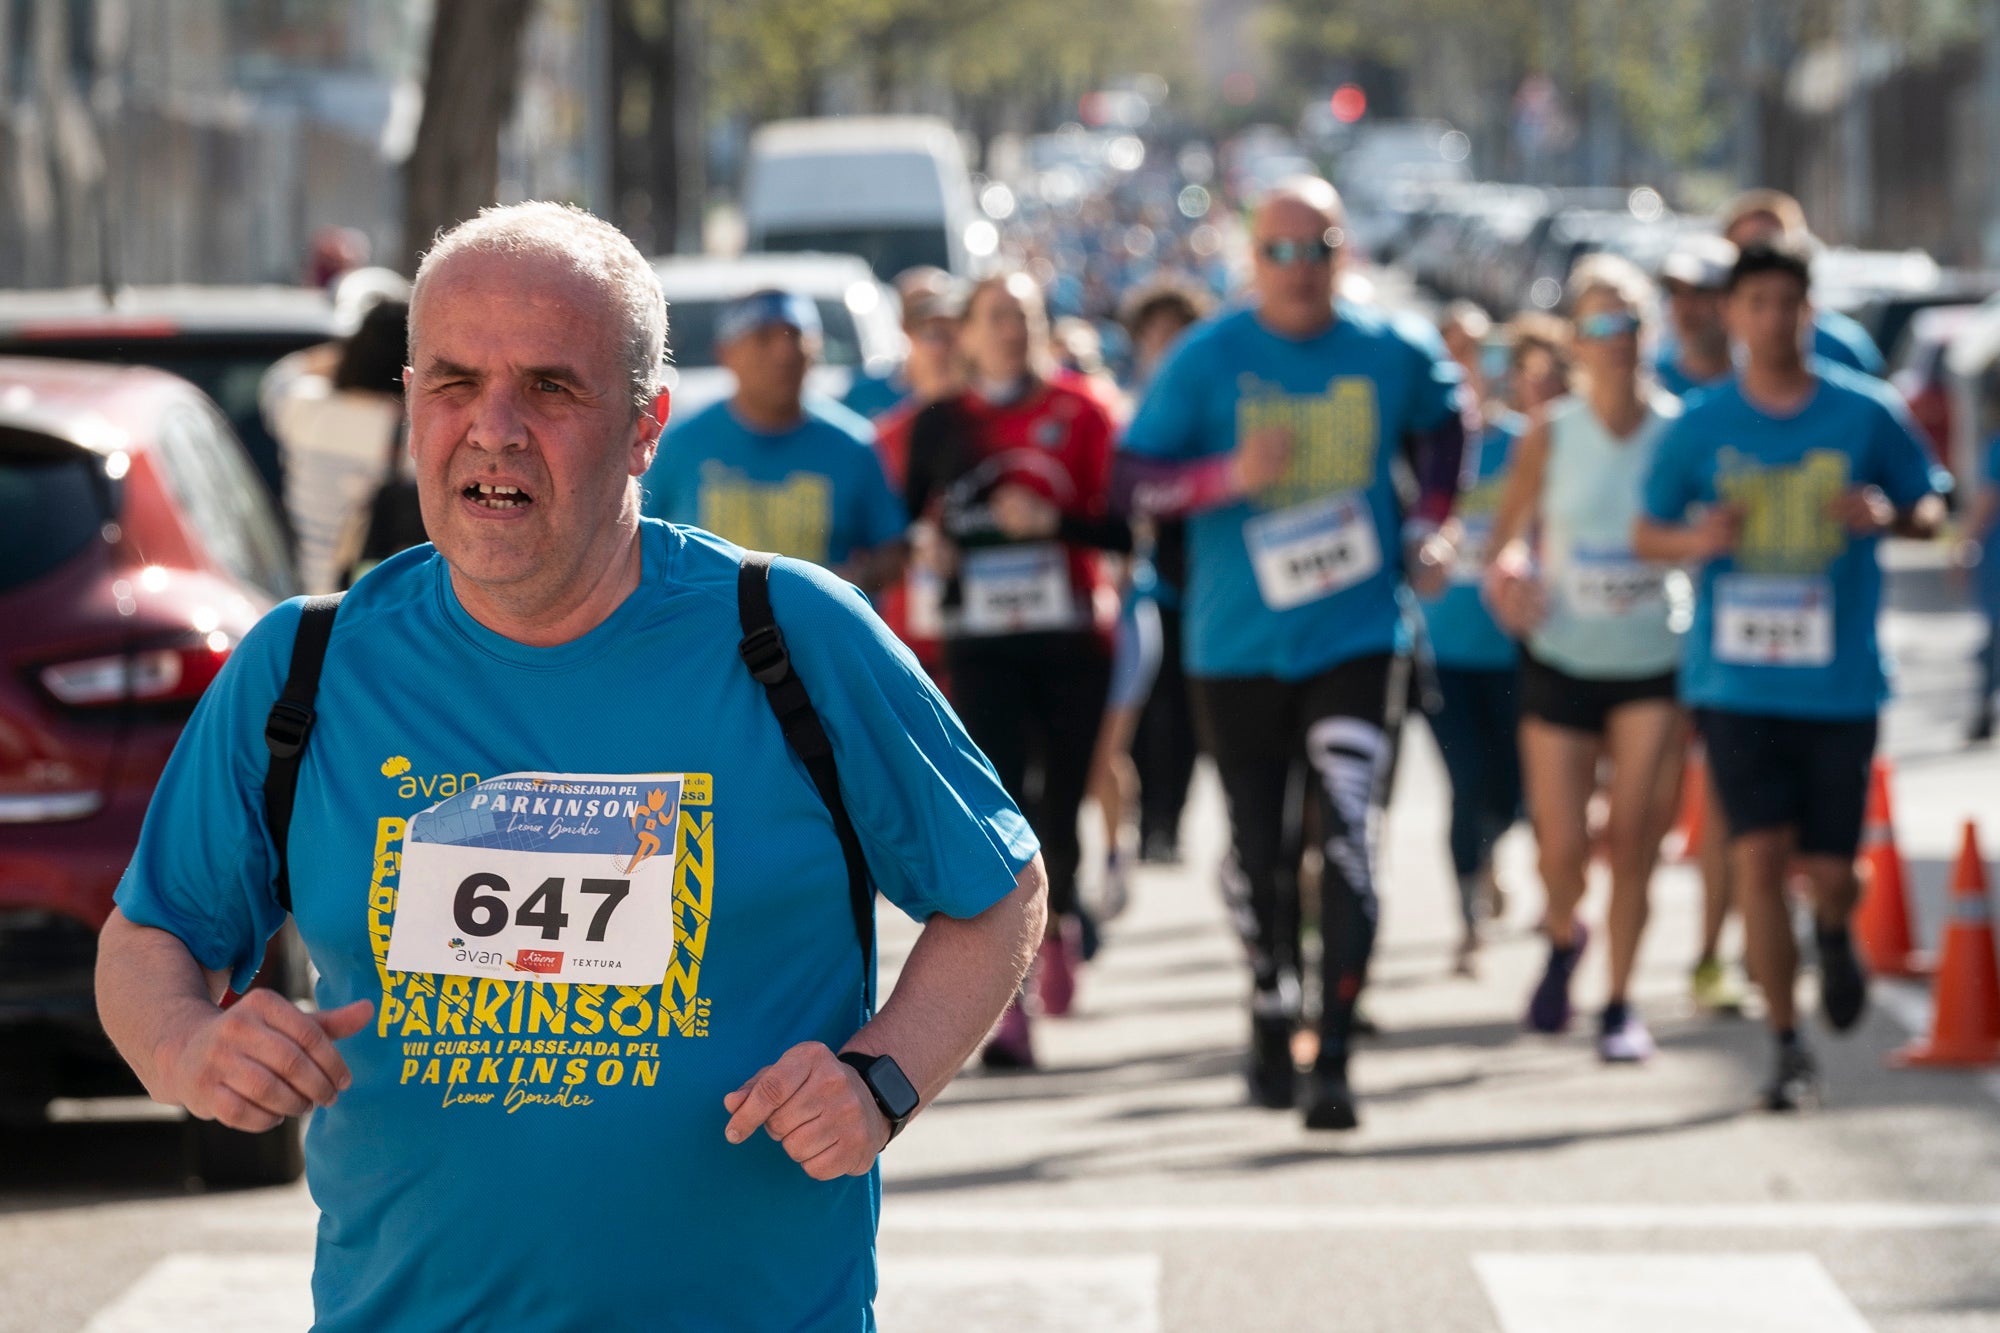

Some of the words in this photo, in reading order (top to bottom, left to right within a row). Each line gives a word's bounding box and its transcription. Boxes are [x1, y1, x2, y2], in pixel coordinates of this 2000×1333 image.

[398, 772, 481, 798] avan
[549, 784, 617, 796] PASSEJADA
[618, 786, 638, 796] PEL
[470, 794, 640, 818] PARKINSON
[507, 813, 544, 833] Leonor
[548, 815, 601, 840] González
[453, 872, 631, 942] 647
[455, 949, 503, 966] avan
[572, 958, 623, 969] TEXTURA
[378, 994, 698, 1038] PARKINSON
[695, 998, 712, 1037] 2025
[402, 1041, 429, 1056] VIII
[433, 1040, 491, 1055] CURSA
[495, 1040, 504, 1054] I
[507, 1040, 620, 1056] PASSEJADA
[625, 1043, 660, 1057] PEL
[399, 1057, 661, 1087] PARKINSON
[442, 1081, 495, 1108] Leonor
[503, 1079, 594, 1114] González
